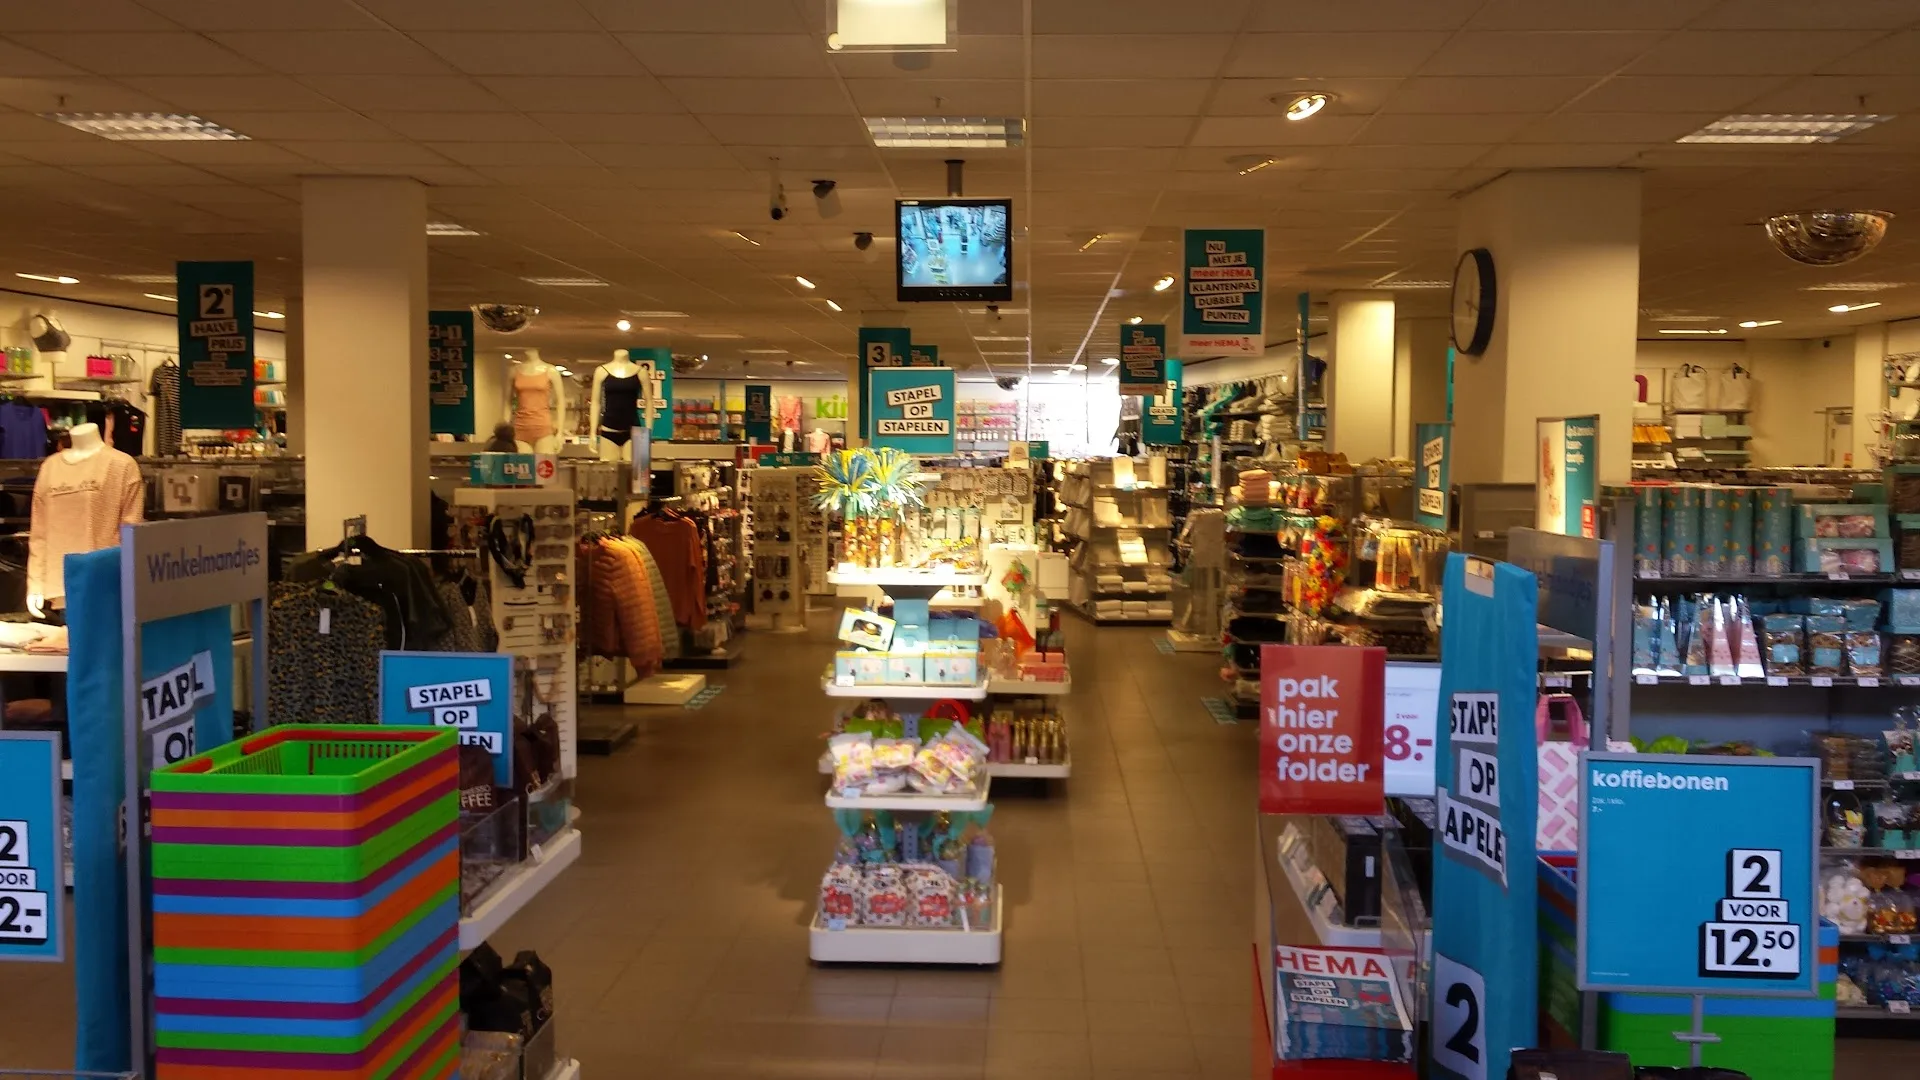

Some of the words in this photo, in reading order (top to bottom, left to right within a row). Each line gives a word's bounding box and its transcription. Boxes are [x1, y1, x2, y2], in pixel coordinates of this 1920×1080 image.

[1208, 244, 1224, 252] NU
[1212, 256, 1232, 265] MET
[1233, 254, 1243, 263] JE
[1221, 270, 1253, 278] HEMA
[1192, 282, 1257, 293] KLANTENPAS
[1198, 296, 1241, 306] DUBBELE
[1206, 311, 1247, 321] PUNTEN
[193, 322, 237, 335] HALVE
[1214, 340, 1241, 348] HEMA
[872, 346, 886, 363] 3
[893, 388, 937, 403] STAPEL
[909, 405, 928, 416] OP
[883, 421, 944, 432] STAPELEN
[147, 538, 260, 583] Winkelmandjes
[419, 684, 484, 703] STAPEL
[1278, 675, 1339, 700] pak
[443, 710, 469, 725] OP
[1278, 703, 1338, 729] hier
[1277, 734, 1354, 754] onze
[1277, 758, 1370, 782] folder
[1592, 769, 1729, 791] koffiebonen
[0, 825, 19, 862] 2
[1742, 855, 1771, 892] 2
[1729, 903, 1781, 918] VOOR
[1275, 951, 1388, 978] HEMA
[1296, 980, 1333, 988] STAPEL
[1293, 994, 1346, 1005] STAPELEN
[1446, 982, 1479, 1064] 2
